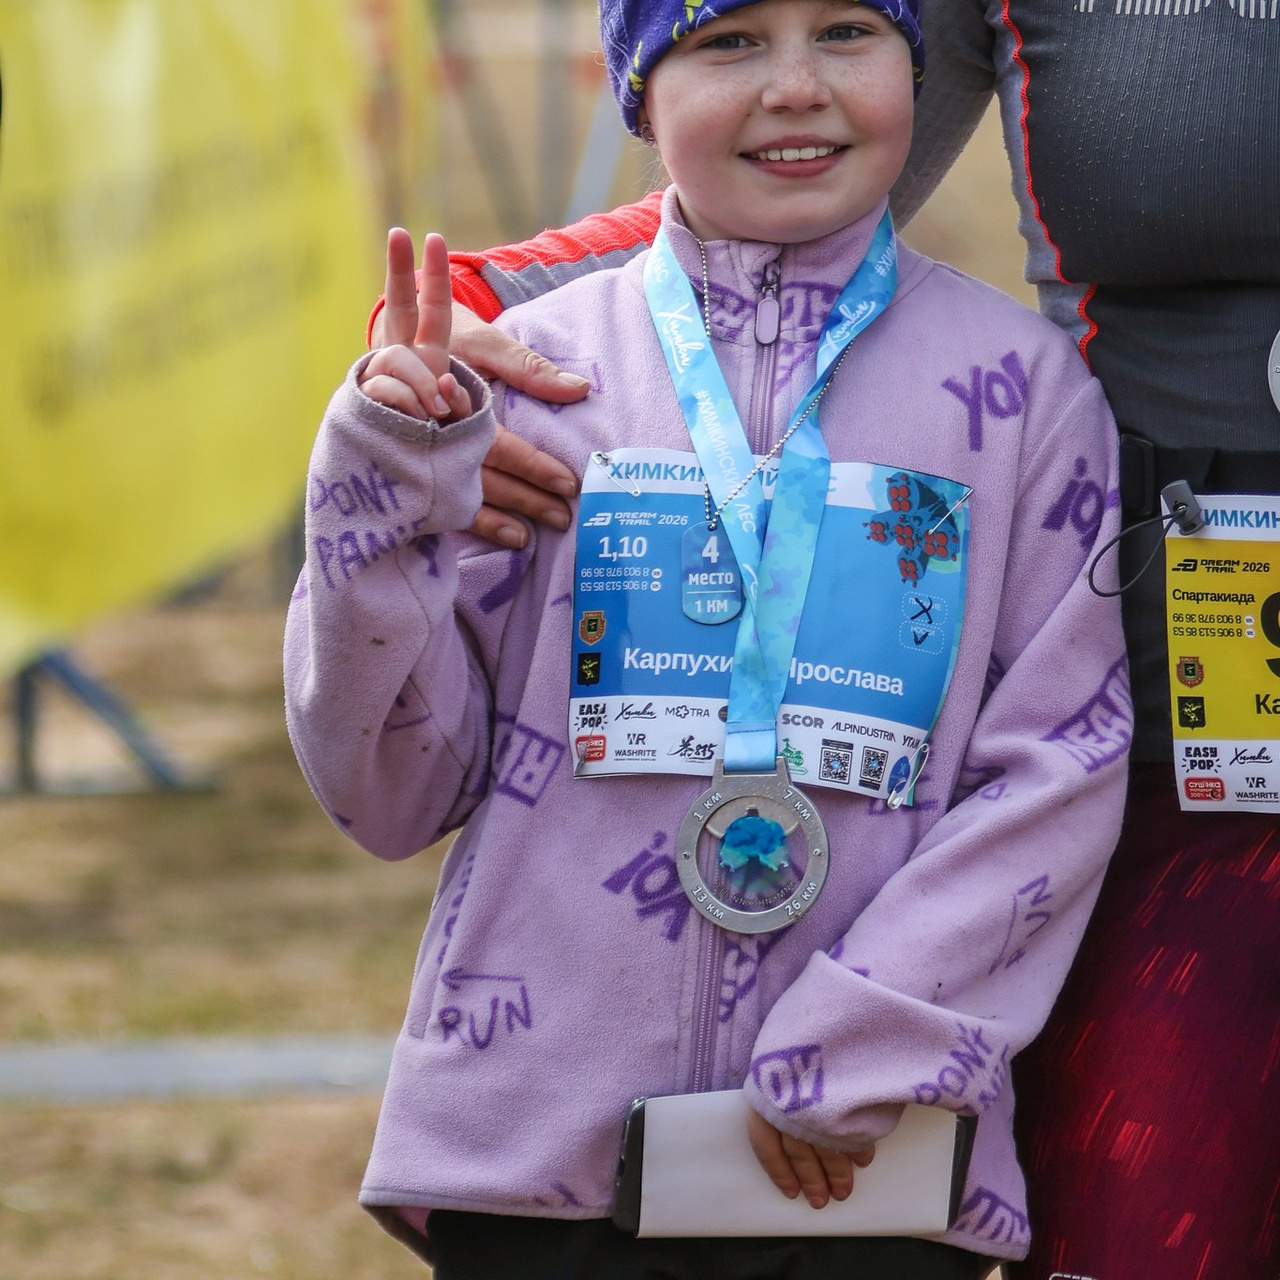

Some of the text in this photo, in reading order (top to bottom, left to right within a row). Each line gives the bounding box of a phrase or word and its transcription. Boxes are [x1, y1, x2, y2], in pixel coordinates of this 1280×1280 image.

[608, 461, 779, 489] ХИМКИНИЙ
[614, 512, 658, 520] DREAM
[657, 514, 689, 526] 2026
[599, 536, 648, 562] 1,10
[702, 536, 720, 564] 4
[1200, 559, 1241, 567] DREAM
[1242, 562, 1271, 573] 2026
[580, 568, 593, 578] 99
[593, 568, 605, 578] 36
[606, 567, 622, 577] 978
[624, 567, 642, 577] 903
[643, 567, 650, 577] 8
[1205, 566, 1237, 574] TRAIL
[688, 573, 734, 586] место
[580, 582, 592, 592] 53
[641, 580, 648, 590] 8
[1172, 588, 1256, 606] Спартакиада
[694, 600, 728, 614] 1 КМ
[1172, 613, 1184, 623] 99
[1185, 613, 1197, 623] 36
[1198, 614, 1215, 624] 978
[1217, 614, 1234, 624] 903
[1235, 615, 1242, 624] 8
[1173, 626, 1184, 636] 53
[1186, 627, 1197, 637] 85
[1199, 627, 1216, 637] 513
[1217, 627, 1235, 637] 905
[1236, 628, 1243, 637] 8
[623, 647, 733, 675] Карпухи
[781, 712, 825, 729] SCOR
[614, 749, 657, 757] WASHRITE
[1184, 746, 1218, 758] EASY
[1189, 759, 1215, 770] POP
[1235, 791, 1280, 799] WASHRITE
[691, 886, 708, 903] 13
[784, 900, 801, 917] 26
[437, 984, 532, 1050] RUN
